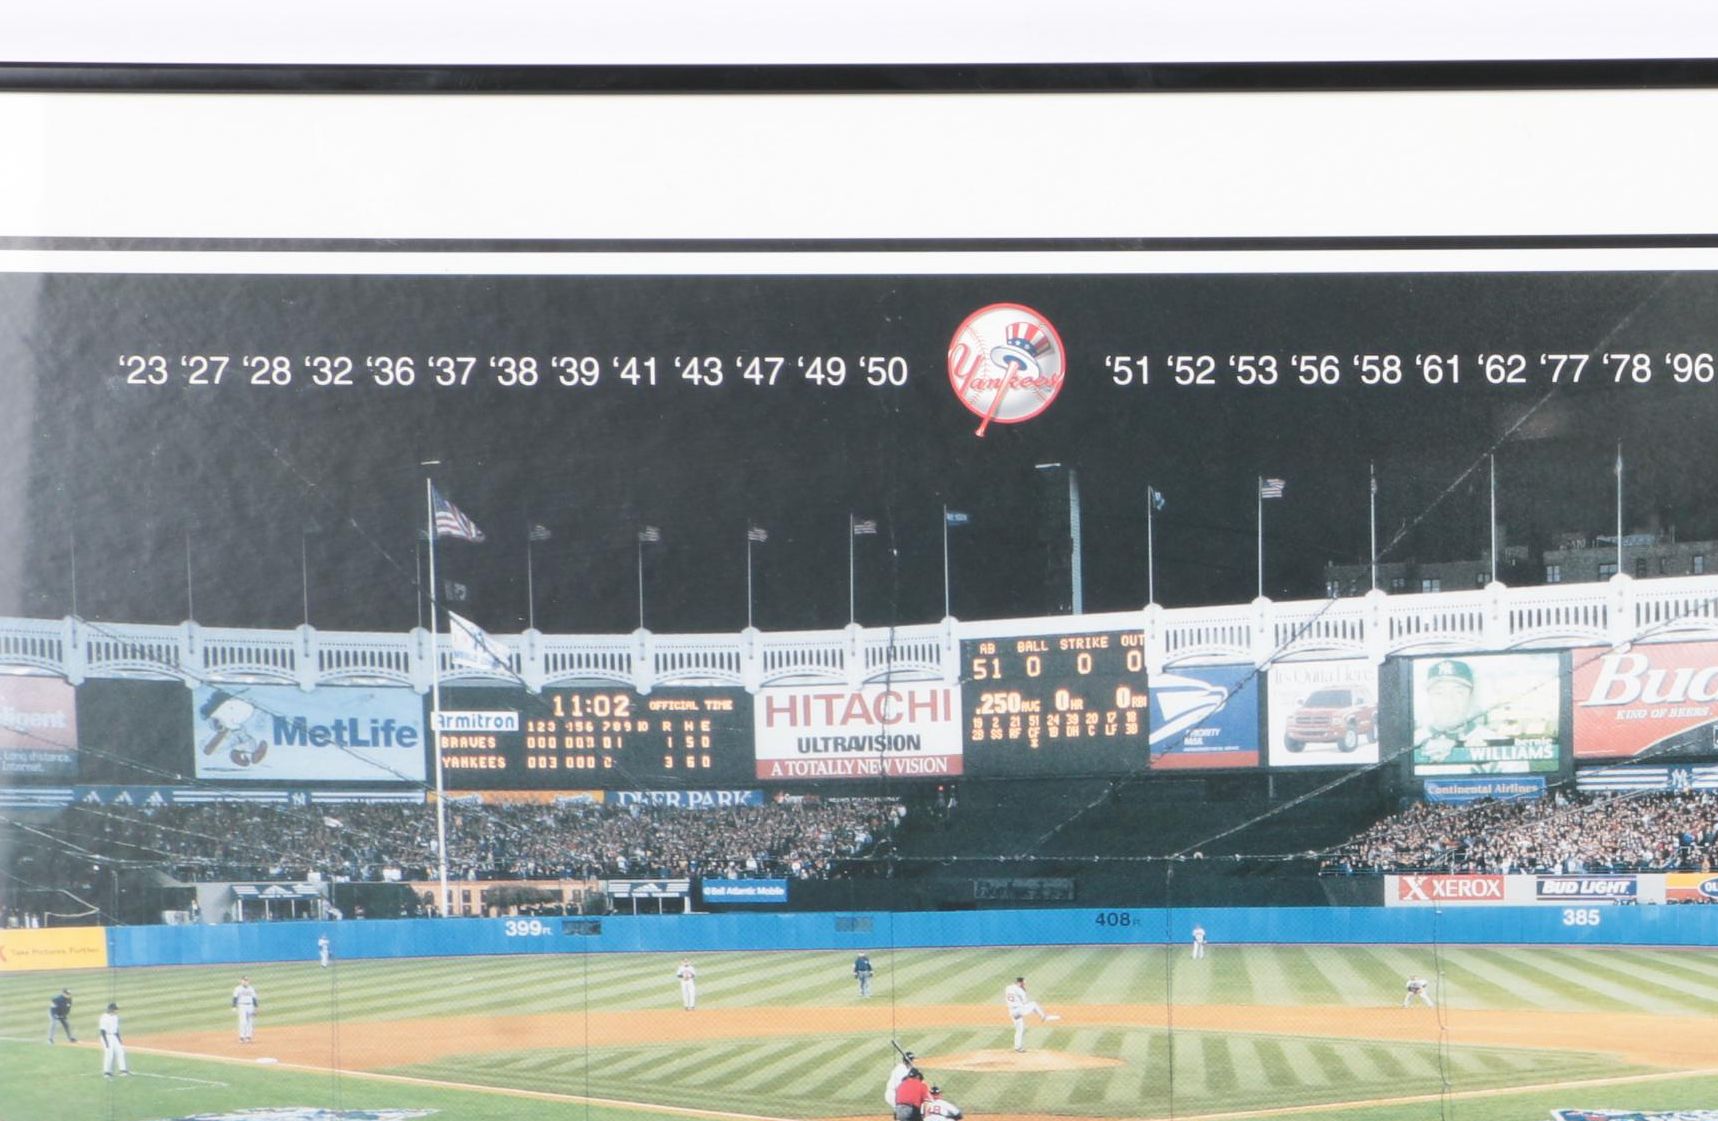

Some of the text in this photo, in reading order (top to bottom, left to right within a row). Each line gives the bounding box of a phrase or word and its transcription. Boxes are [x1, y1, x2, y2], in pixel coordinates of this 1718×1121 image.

[119, 355, 907, 385] '23 '27 '28 '32 '36 '37 '38 '39 '41 '43 '47 '49 '50
[948, 343, 1065, 396] Yankees
[1106, 356, 1147, 385] '51
[1168, 356, 1215, 385] '52
[1230, 356, 1277, 384] '53
[1292, 355, 1339, 384] '56
[1354, 355, 1401, 384] '58
[1416, 355, 1458, 383] '61
[1478, 354, 1526, 383] '62
[1541, 354, 1589, 382] '77
[1603, 354, 1651, 382] '78
[1666, 353, 1714, 382] '96
[980, 634, 1146, 655] AB BALL STRIKE OUT
[972, 650, 1142, 680] 51 0 0 0
[553, 695, 733, 717] 11:02 OFFICIAL TIME
[766, 688, 951, 728] HITACHI
[1651, 709, 1668, 718] OF
[438, 714, 515, 729] Armitron
[662, 721, 672, 732] R
[684, 720, 695, 732] H
[700, 720, 711, 732] E
[273, 716, 418, 748] MetLife
[441, 736, 497, 749] BRAVES
[797, 734, 921, 754] ULTRAVISION
[1470, 745, 1553, 761] WILLIAMS
[442, 756, 506, 769] YANKEES
[771, 757, 948, 776] A TOTALLY NEW VISION
[1428, 783, 1538, 795] Continental Airlines
[1432, 879, 1501, 898] XEROX
[1542, 880, 1630, 895] BUD LIGHT
[1095, 912, 1131, 926] 408
[1563, 909, 1601, 926] 385
[505, 919, 542, 936] 399
